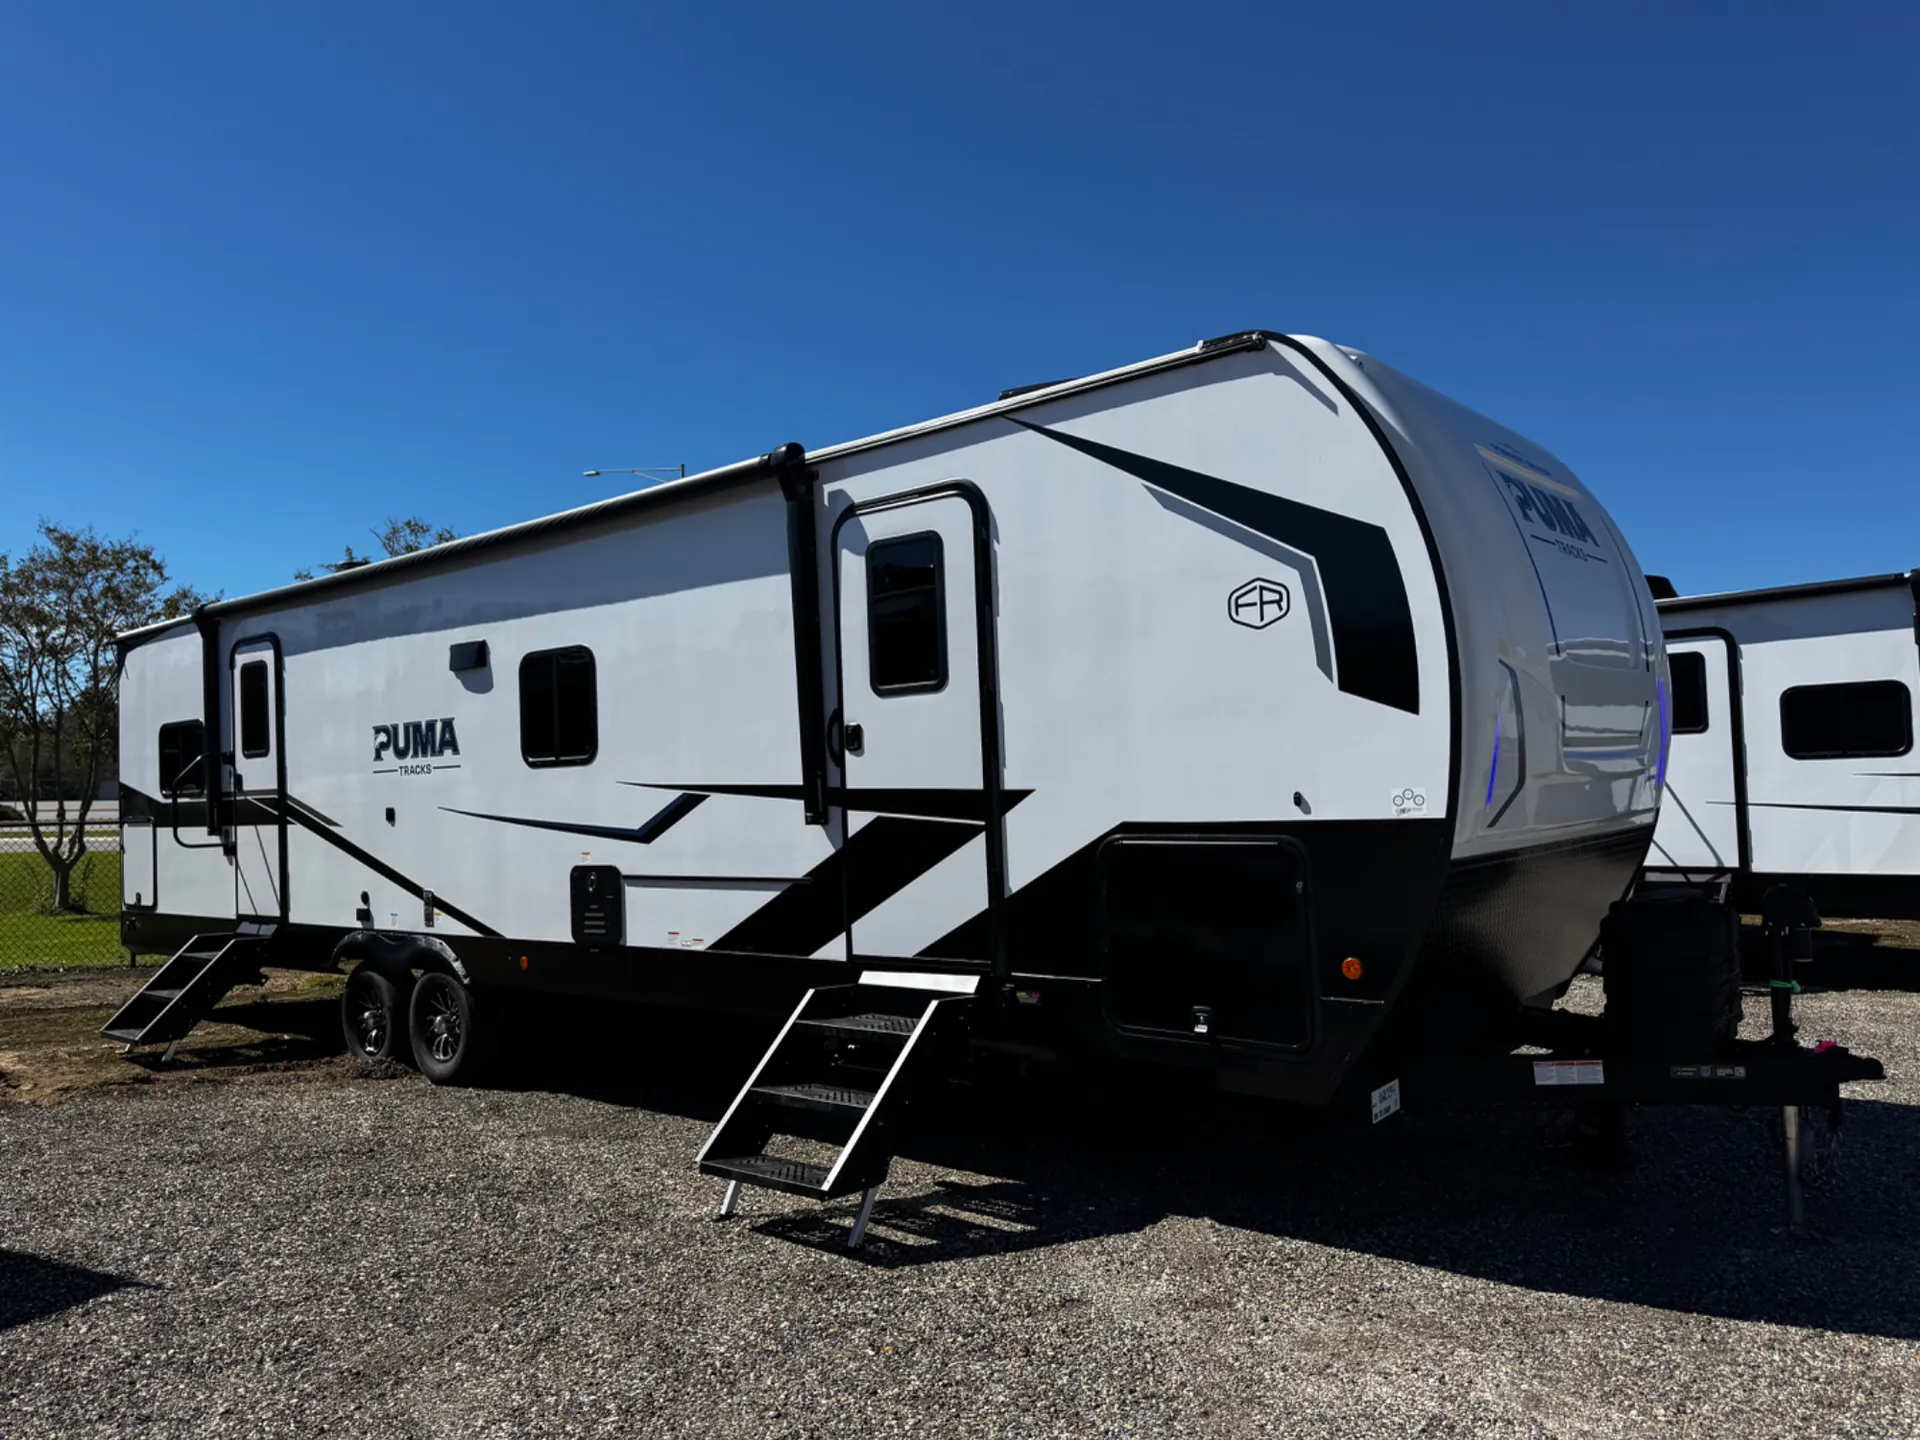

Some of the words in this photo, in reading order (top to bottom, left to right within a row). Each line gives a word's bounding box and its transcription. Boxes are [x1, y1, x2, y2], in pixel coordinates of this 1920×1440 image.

[1495, 468, 1600, 549] PUMA
[372, 716, 461, 762] PUMA
[398, 763, 432, 776] TRACKS
